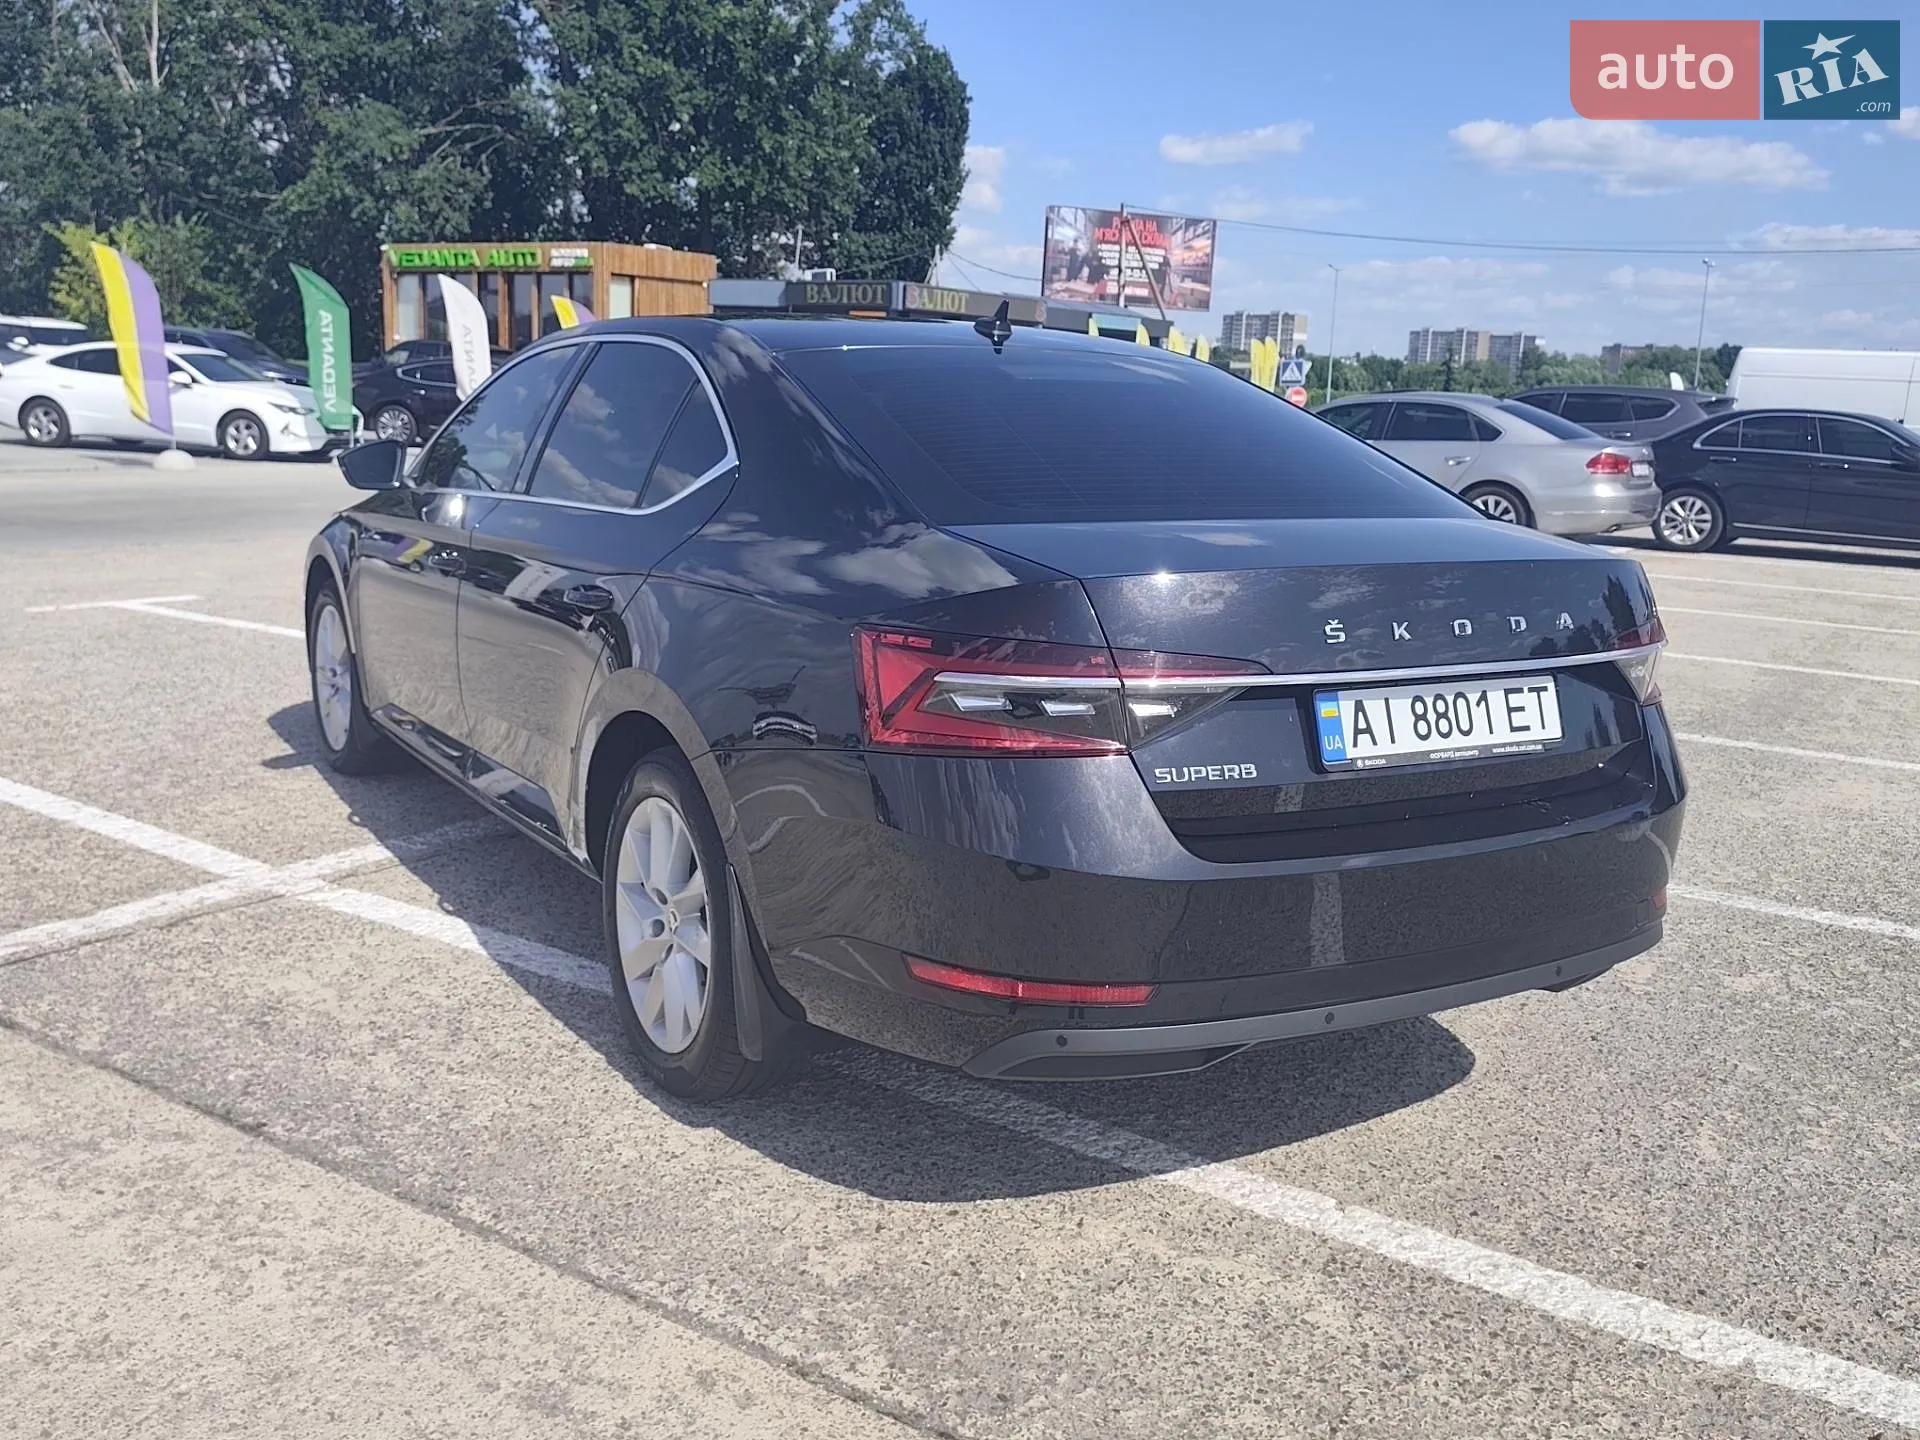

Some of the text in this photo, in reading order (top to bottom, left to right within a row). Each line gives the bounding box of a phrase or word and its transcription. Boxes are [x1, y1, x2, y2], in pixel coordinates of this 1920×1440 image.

[389, 248, 480, 267] VEDANTA
[486, 248, 542, 266] AUTO
[806, 284, 887, 305] ВАЛЮТ
[1324, 612, 1575, 644] ŠKODA
[1353, 686, 1549, 749] AI 8801 ET
[1324, 735, 1344, 751] UA
[1154, 763, 1258, 783] SUPERB
